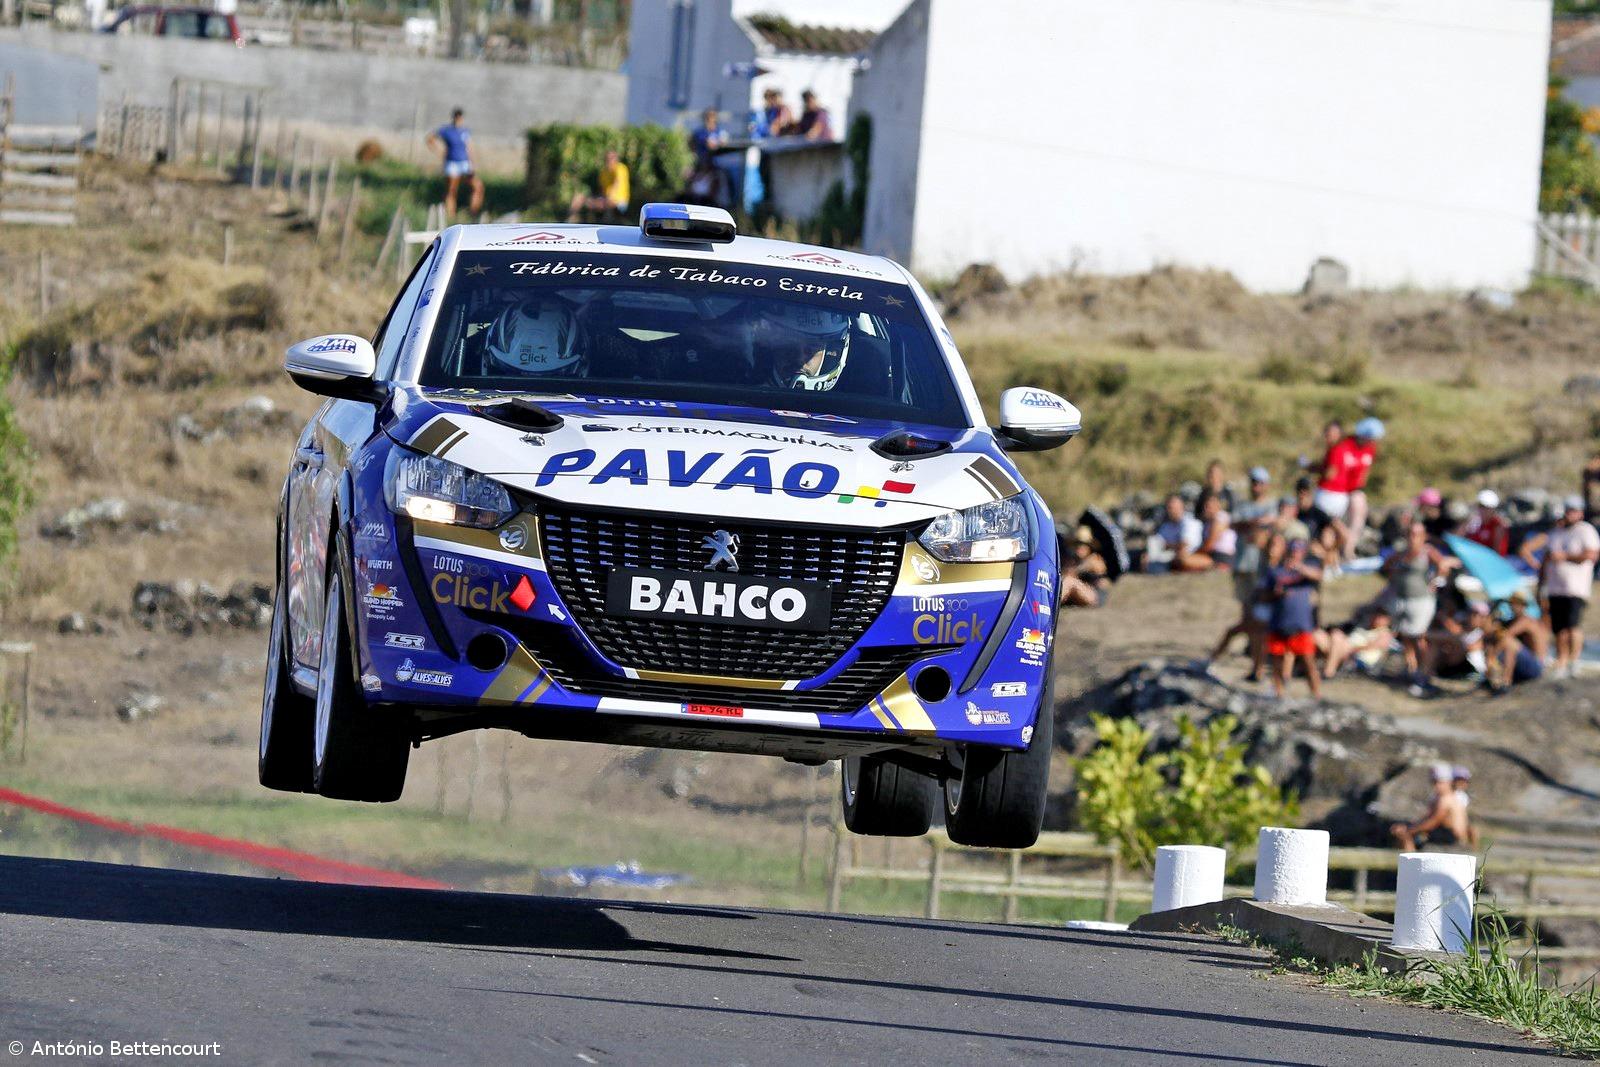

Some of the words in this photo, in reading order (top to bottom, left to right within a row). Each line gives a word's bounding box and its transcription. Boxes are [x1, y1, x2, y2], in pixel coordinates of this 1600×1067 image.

[510, 262, 620, 276] Fábrica
[629, 265, 661, 278] de
[668, 267, 767, 288] Tabaco
[779, 277, 864, 300] Estrela
[520, 353, 547, 364] Click
[535, 448, 840, 499] PAVÃO
[433, 555, 464, 573] LOTUS
[431, 572, 511, 614] Click
[629, 576, 807, 622] BAHCO
[912, 597, 945, 612] LOTUS
[912, 613, 986, 644] Click
